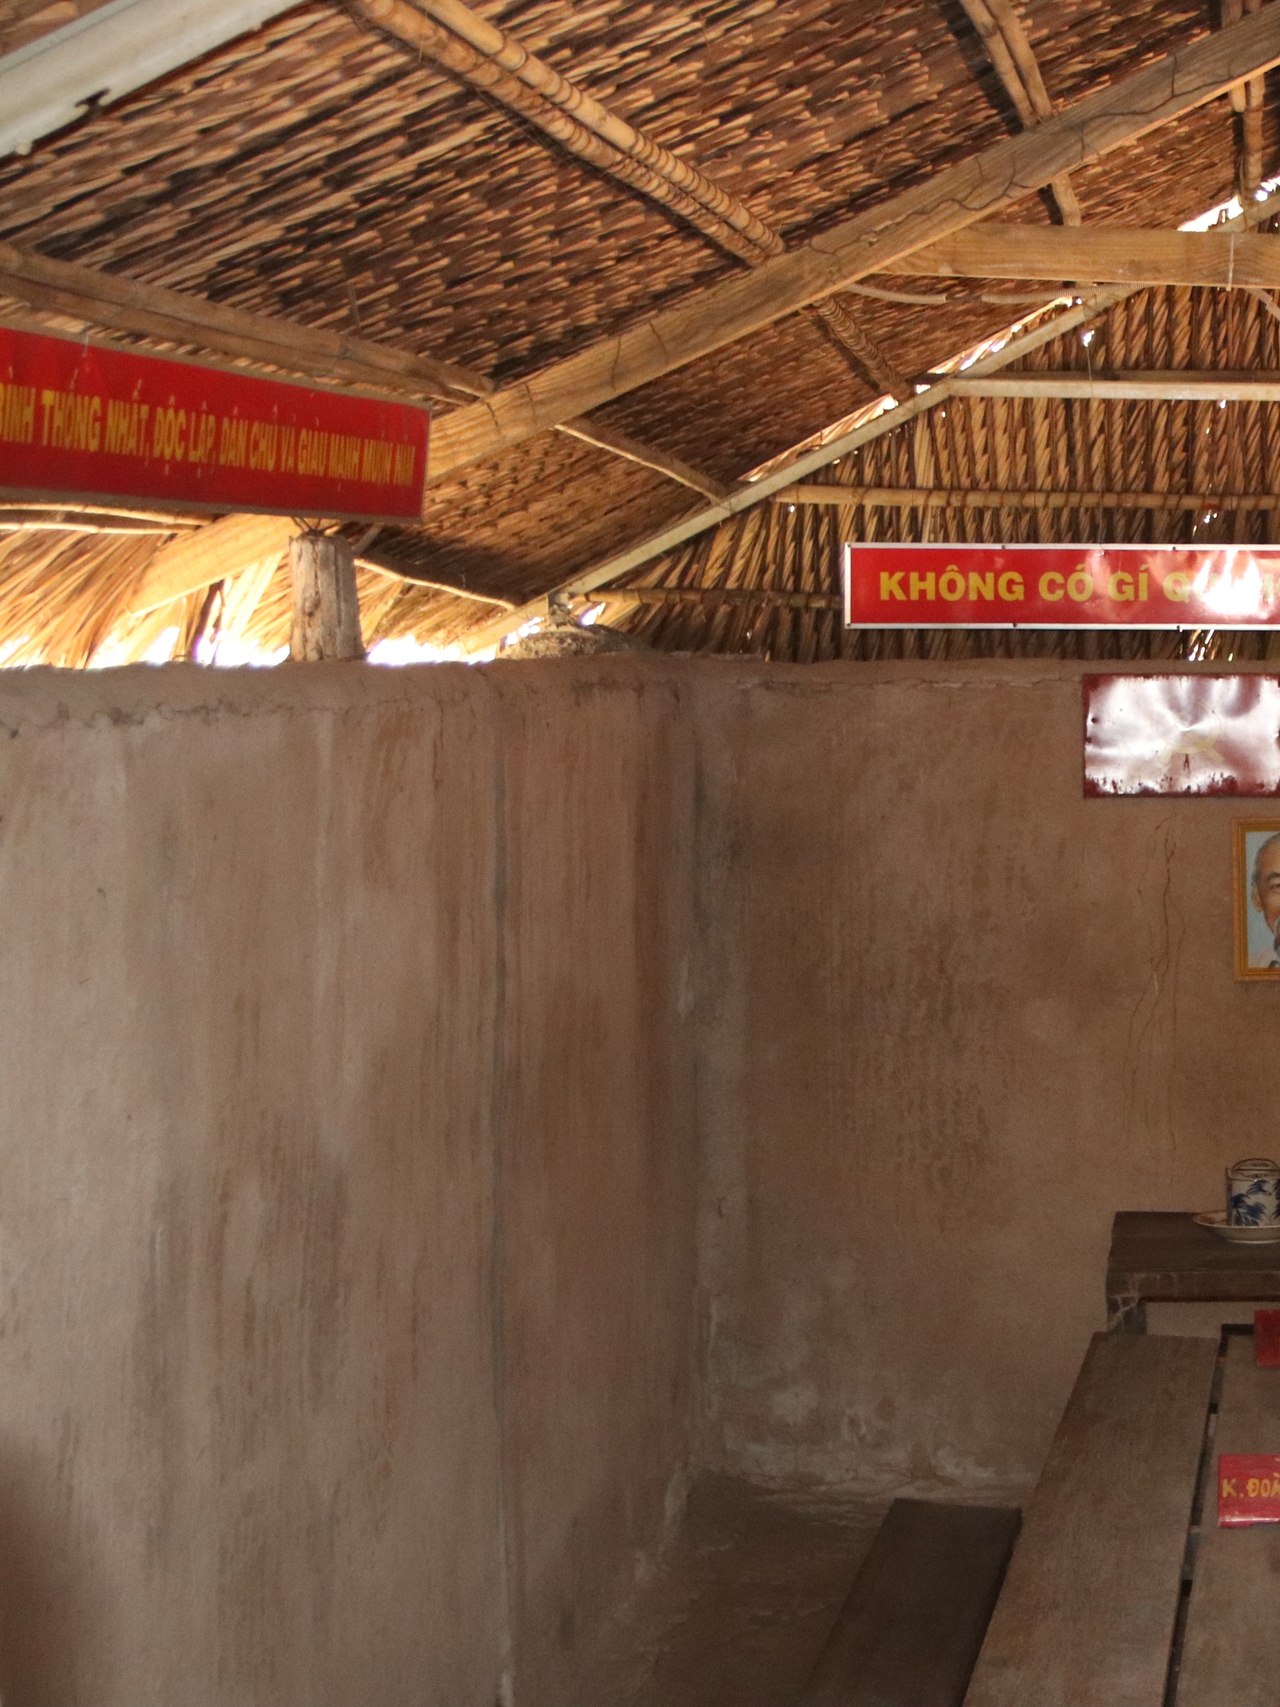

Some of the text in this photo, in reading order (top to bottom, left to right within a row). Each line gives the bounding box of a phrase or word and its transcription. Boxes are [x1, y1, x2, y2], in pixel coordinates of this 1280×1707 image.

[42, 368, 101, 452] THỐNG
[219, 405, 248, 468] DÂN
[250, 404, 278, 472] CHỦ
[880, 564, 1025, 602] KHÔNG
[1038, 563, 1094, 602] CÓ
[1107, 564, 1149, 602] GÍ
